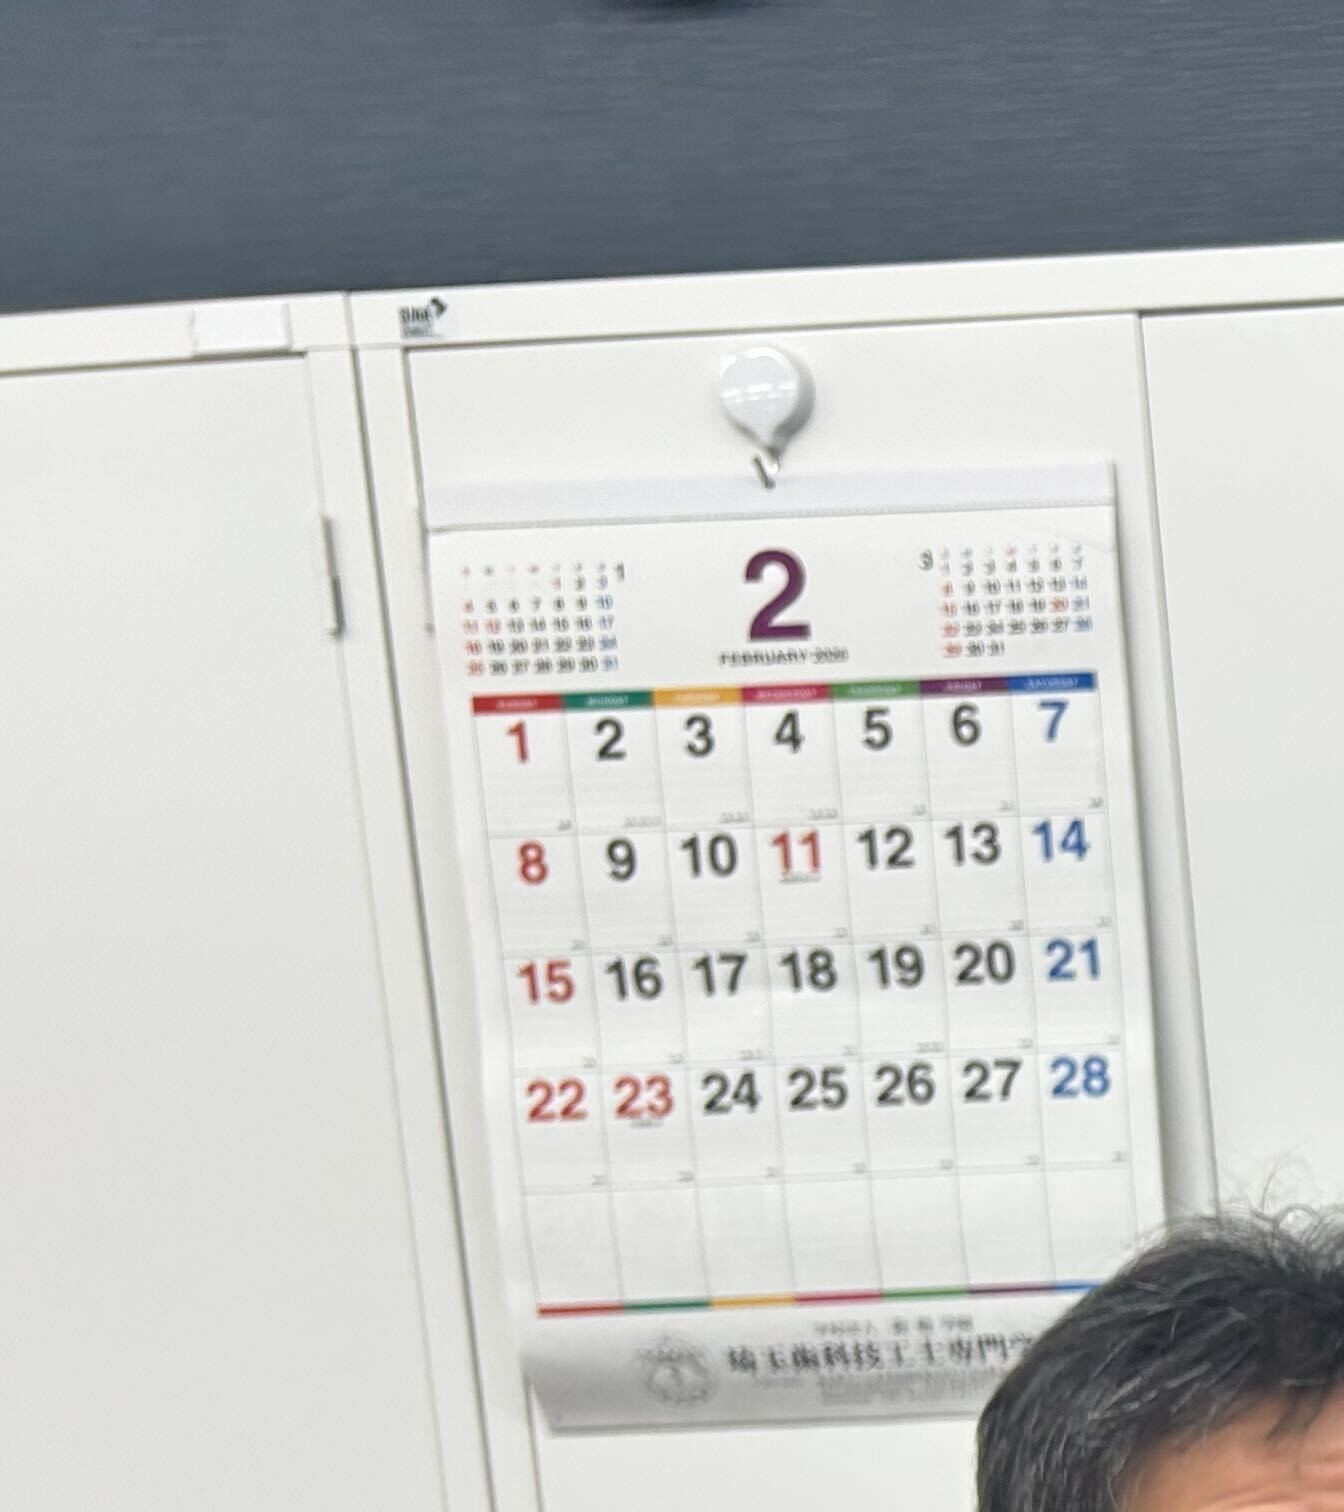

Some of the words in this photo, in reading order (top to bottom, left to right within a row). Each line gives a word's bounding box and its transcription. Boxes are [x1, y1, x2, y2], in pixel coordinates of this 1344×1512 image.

[743, 547, 812, 644] 2
[719, 647, 808, 666] FEBRUARY
[507, 721, 528, 763] 1
[595, 717, 626, 761] 2
[685, 714, 715, 757] 3
[774, 710, 804, 753] 4
[864, 706, 892, 750] 5
[950, 702, 981, 746] 6
[1039, 700, 1070, 741] 7
[518, 841, 548, 885] 8
[606, 838, 636, 881] 9
[680, 833, 737, 877] 10
[772, 831, 820, 877] 11
[858, 825, 914, 870] 12
[944, 822, 1001, 866] 13
[1032, 818, 1089, 862] 14
[518, 960, 574, 1003] 15
[606, 956, 662, 1000] 16
[692, 952, 747, 996] 17
[780, 948, 837, 992] 18
[868, 944, 924, 988] 19
[954, 940, 1015, 985] 20
[1046, 938, 1100, 981] 21
[526, 1078, 586, 1122] 22
[614, 1075, 673, 1119] 23
[702, 1071, 759, 1114] 24
[788, 1066, 848, 1110] 25
[875, 1062, 935, 1107] 26
[963, 1058, 1022, 1102] 27
[1051, 1055, 1110, 1098] 28
